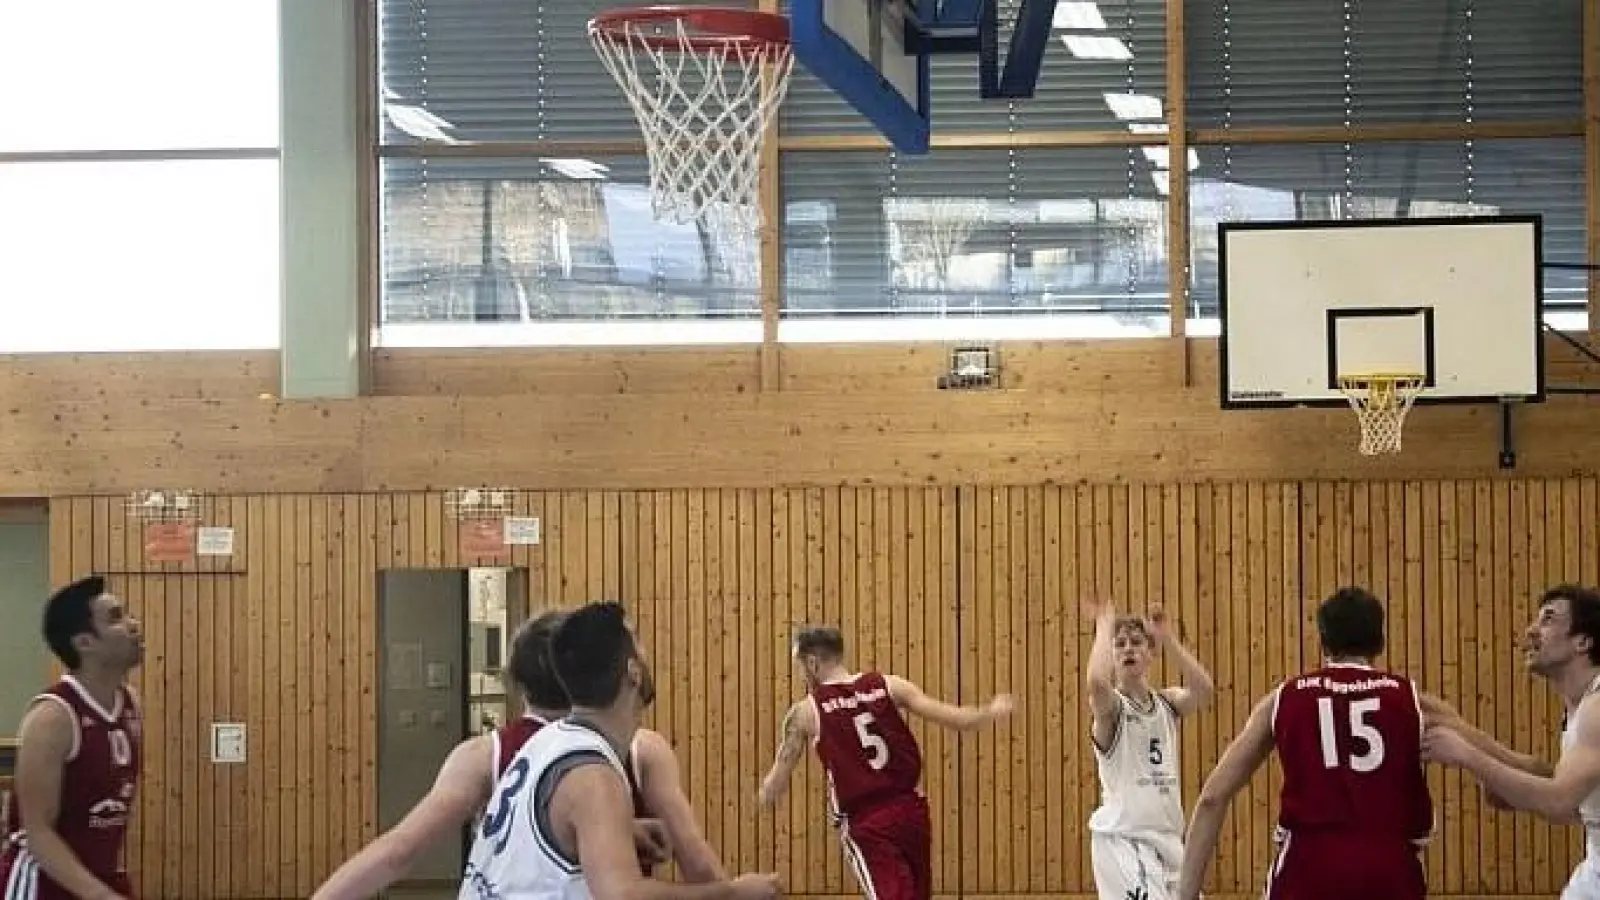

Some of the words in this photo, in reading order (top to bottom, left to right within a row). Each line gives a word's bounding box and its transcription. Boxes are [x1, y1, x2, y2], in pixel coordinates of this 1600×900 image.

[852, 711, 889, 770] 5
[1149, 737, 1163, 765] 5
[1317, 697, 1385, 772] 15
